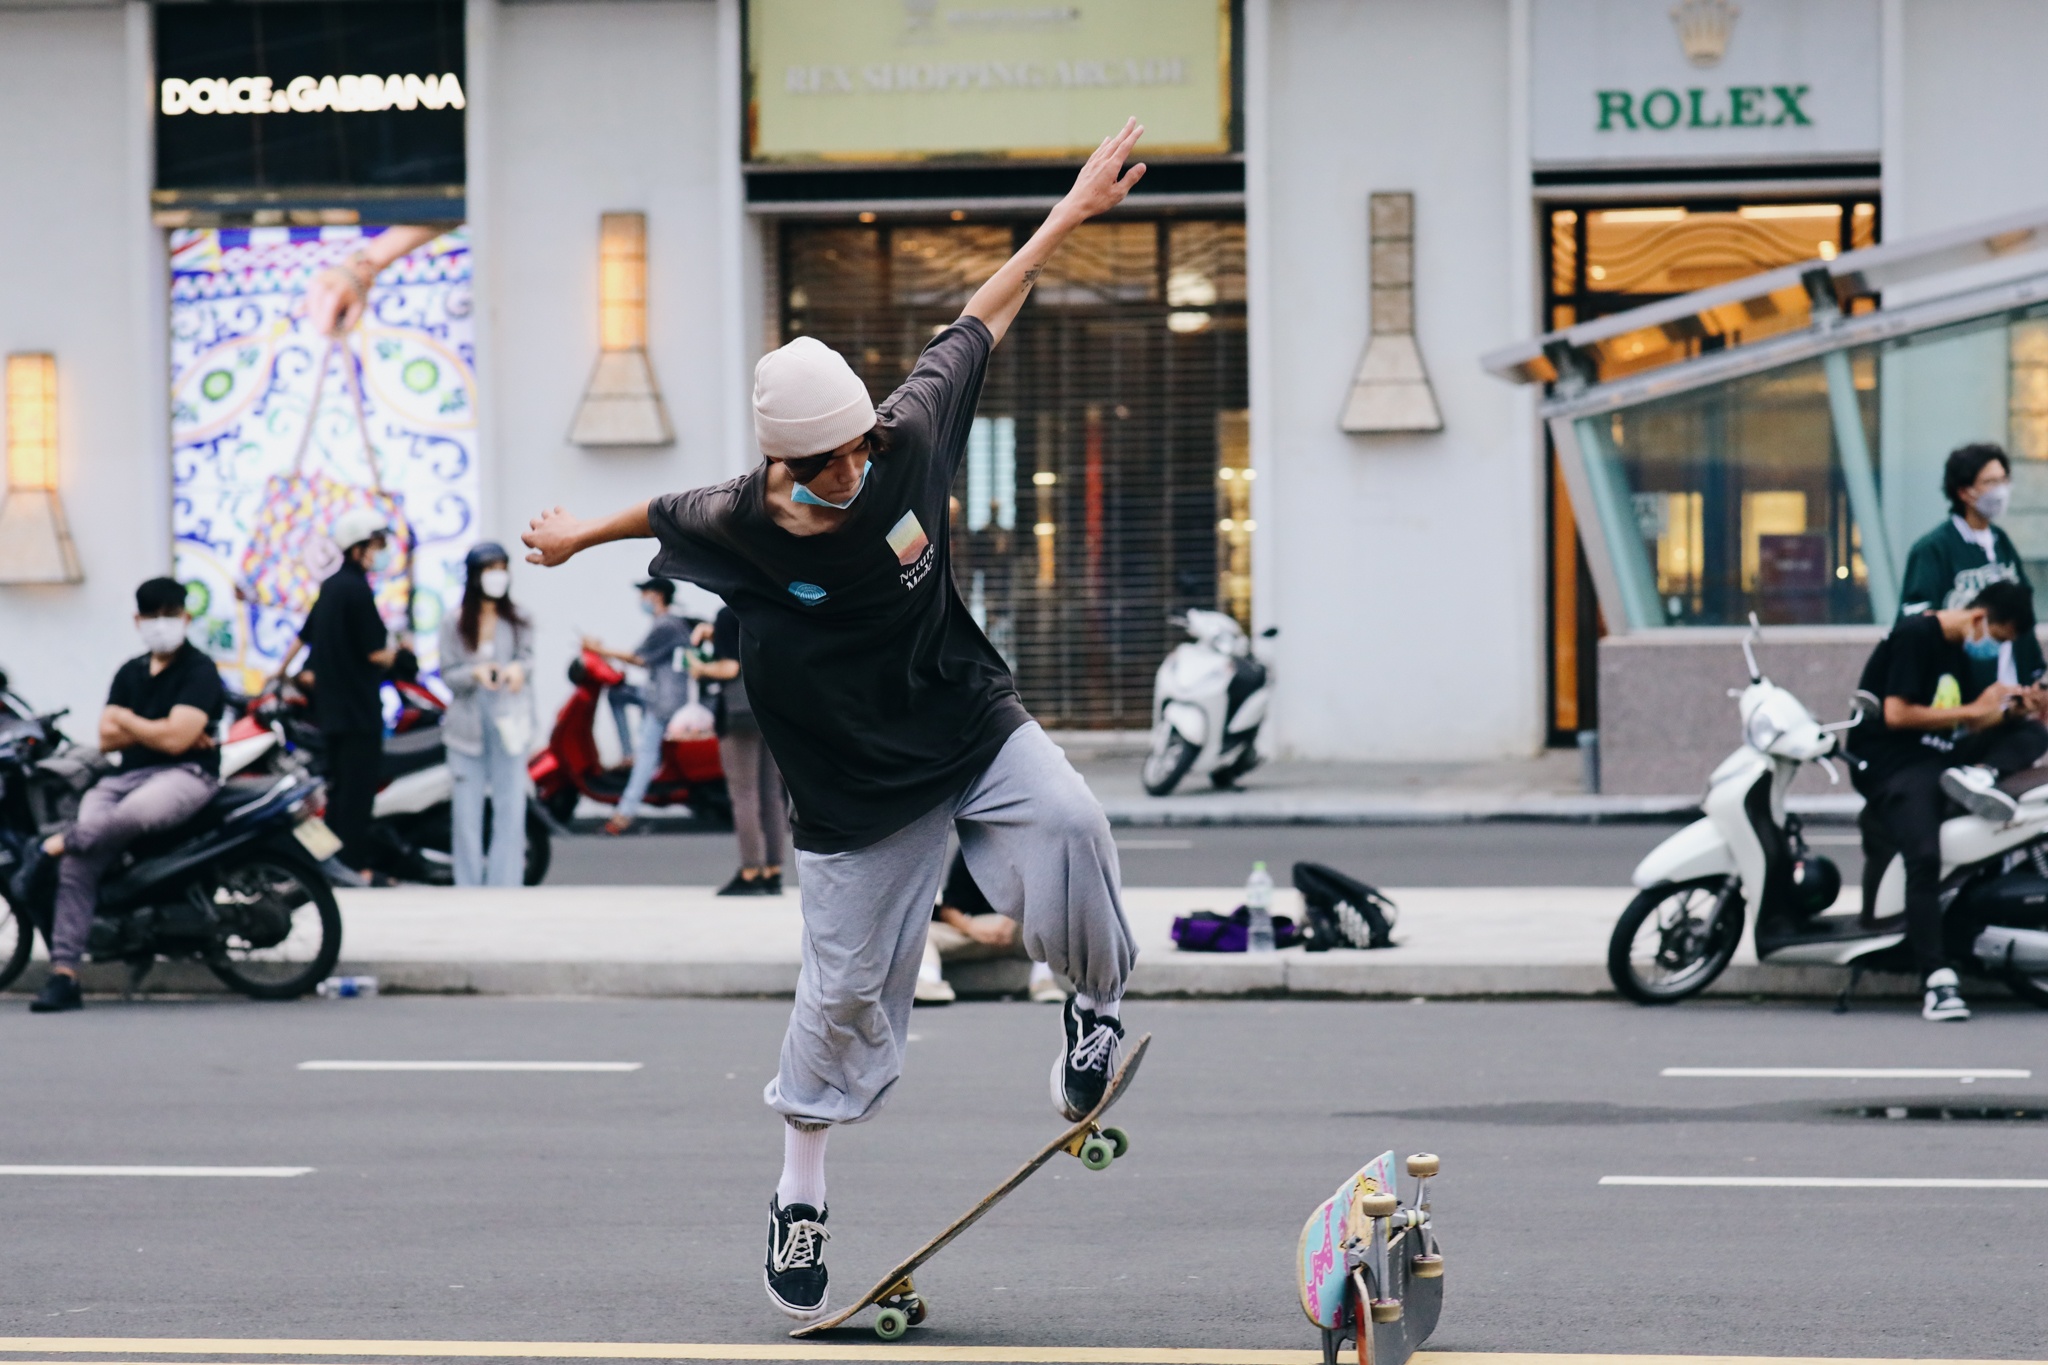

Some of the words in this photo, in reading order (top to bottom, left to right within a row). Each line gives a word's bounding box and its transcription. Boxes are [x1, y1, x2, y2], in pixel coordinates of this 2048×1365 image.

[785, 66, 853, 93] REX
[864, 62, 1044, 91] SHOPPING
[1053, 58, 1188, 87] ARCADE
[1596, 86, 1813, 130] ROLEX
[899, 544, 934, 584] Nature
